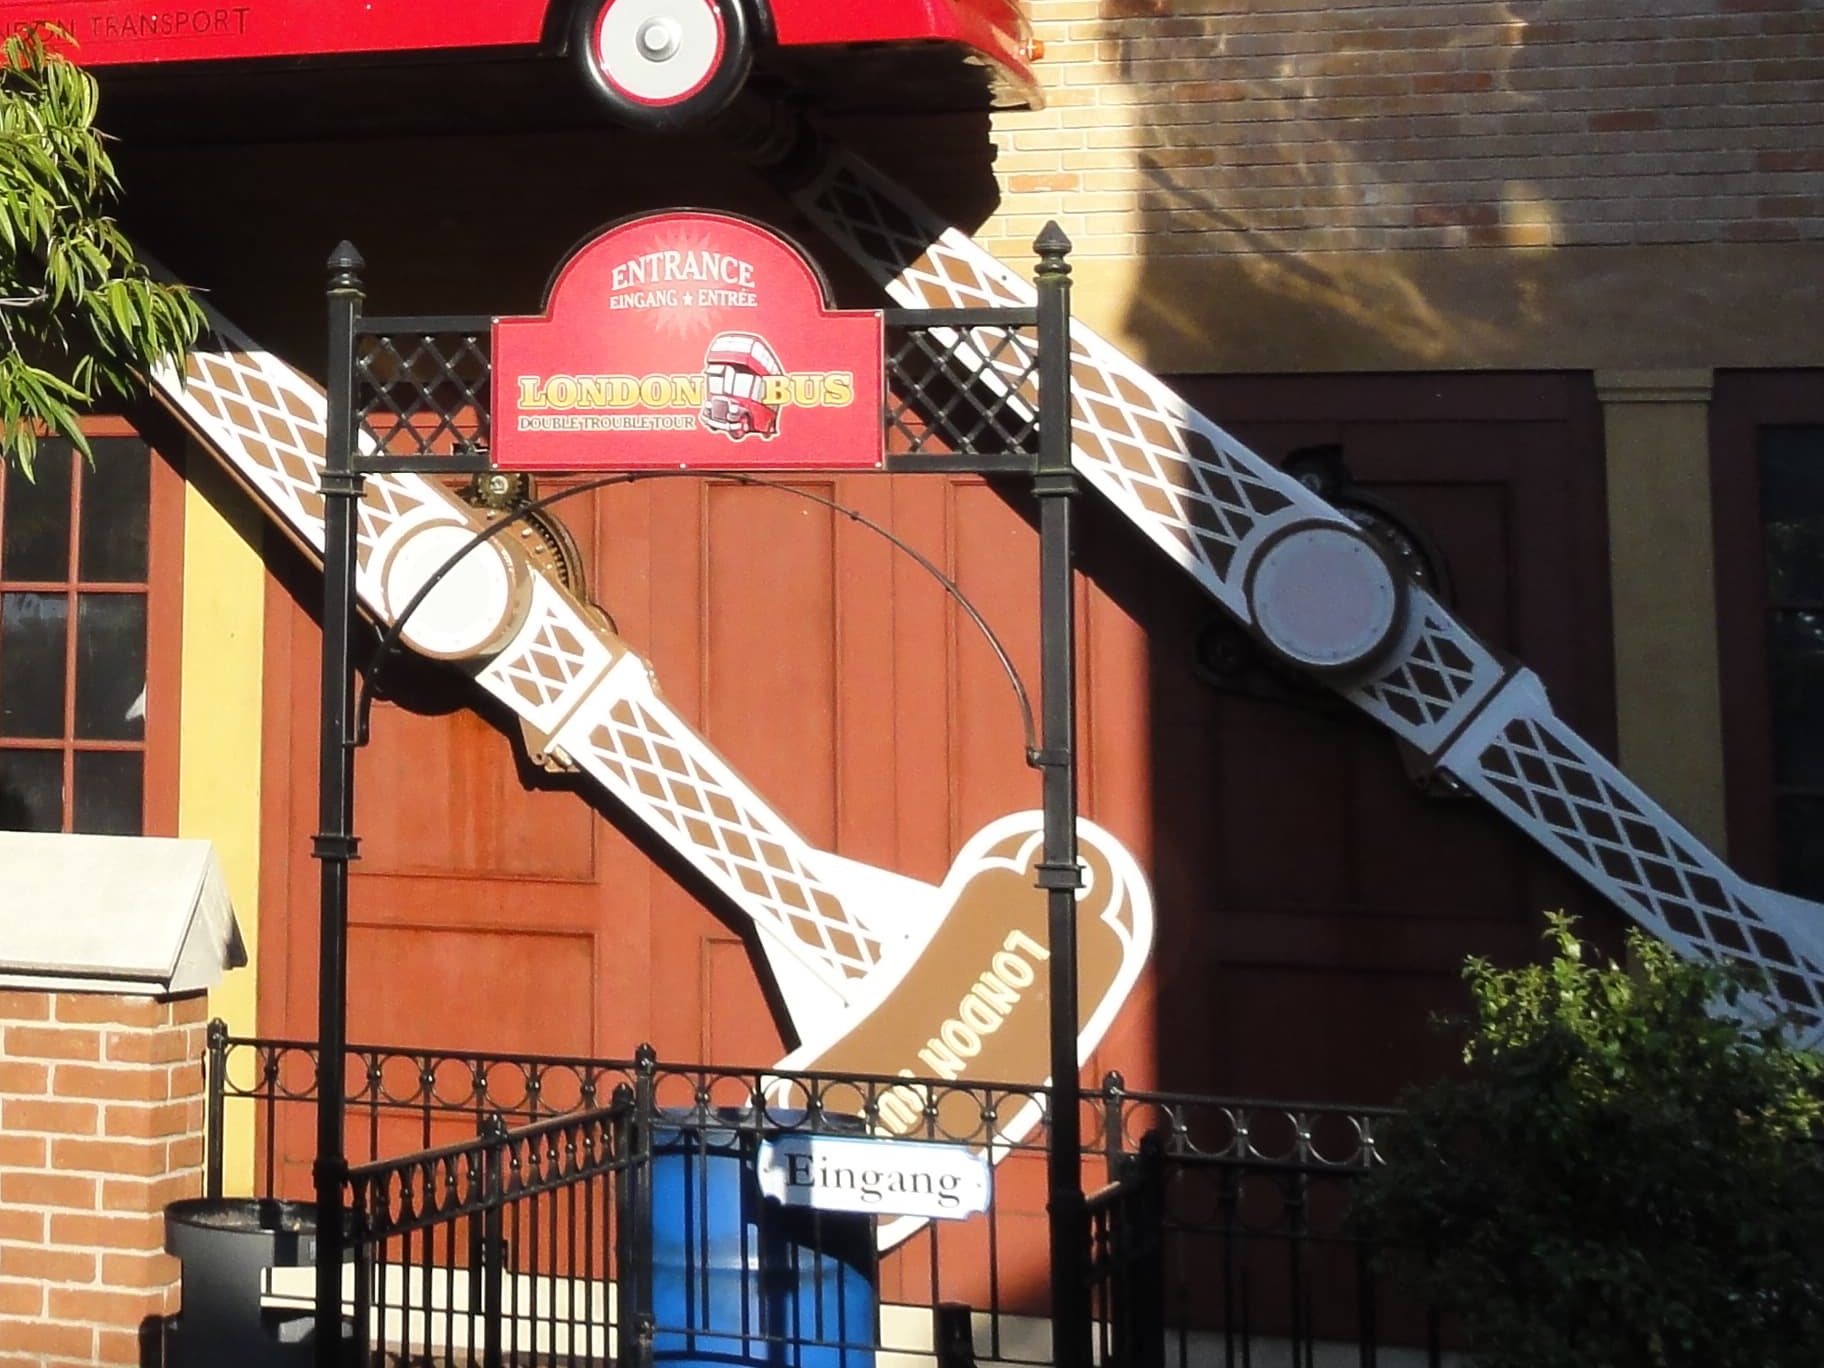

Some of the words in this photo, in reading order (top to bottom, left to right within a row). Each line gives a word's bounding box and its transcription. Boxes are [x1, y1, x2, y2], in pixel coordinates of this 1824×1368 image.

[90, 7, 250, 36] TRANSPORT
[610, 250, 756, 291] ENTRANCE
[609, 288, 678, 310] EINGANG
[697, 287, 758, 307] ENTRÉE
[518, 374, 704, 409] LONDON
[762, 371, 853, 408] BUS
[520, 416, 579, 429] DOUBLE
[581, 416, 652, 429] TROUBLE
[653, 416, 694, 429] TOUR
[918, 928, 1052, 1081] LONDON
[785, 1152, 962, 1209] Eingang
